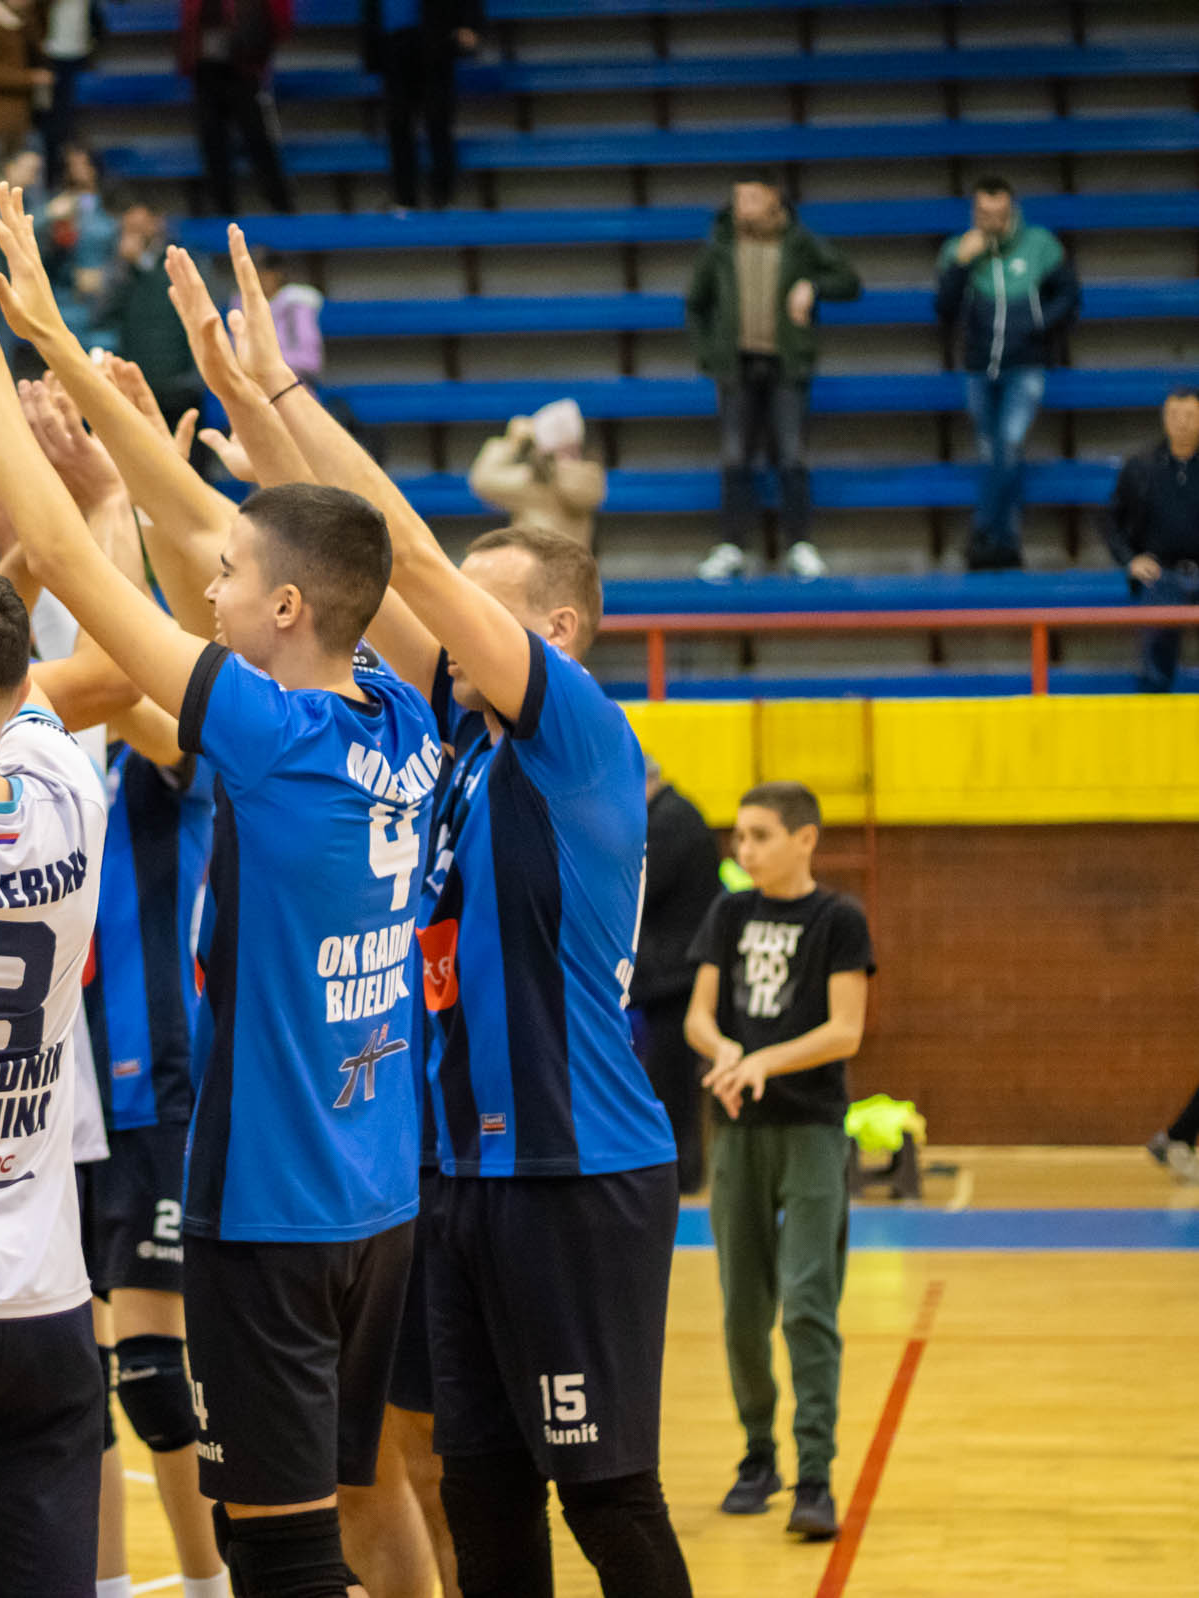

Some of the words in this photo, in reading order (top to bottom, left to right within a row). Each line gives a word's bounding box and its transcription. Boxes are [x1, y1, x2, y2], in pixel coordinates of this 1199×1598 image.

[368, 801, 420, 912] 4
[317, 935, 361, 977] OK
[737, 921, 804, 957] JUST
[745, 951, 789, 986] DO
[154, 1198, 182, 1240] 2
[191, 1381, 209, 1431] 4
[539, 1373, 587, 1422] 15
[552, 1422, 599, 1445] unit
